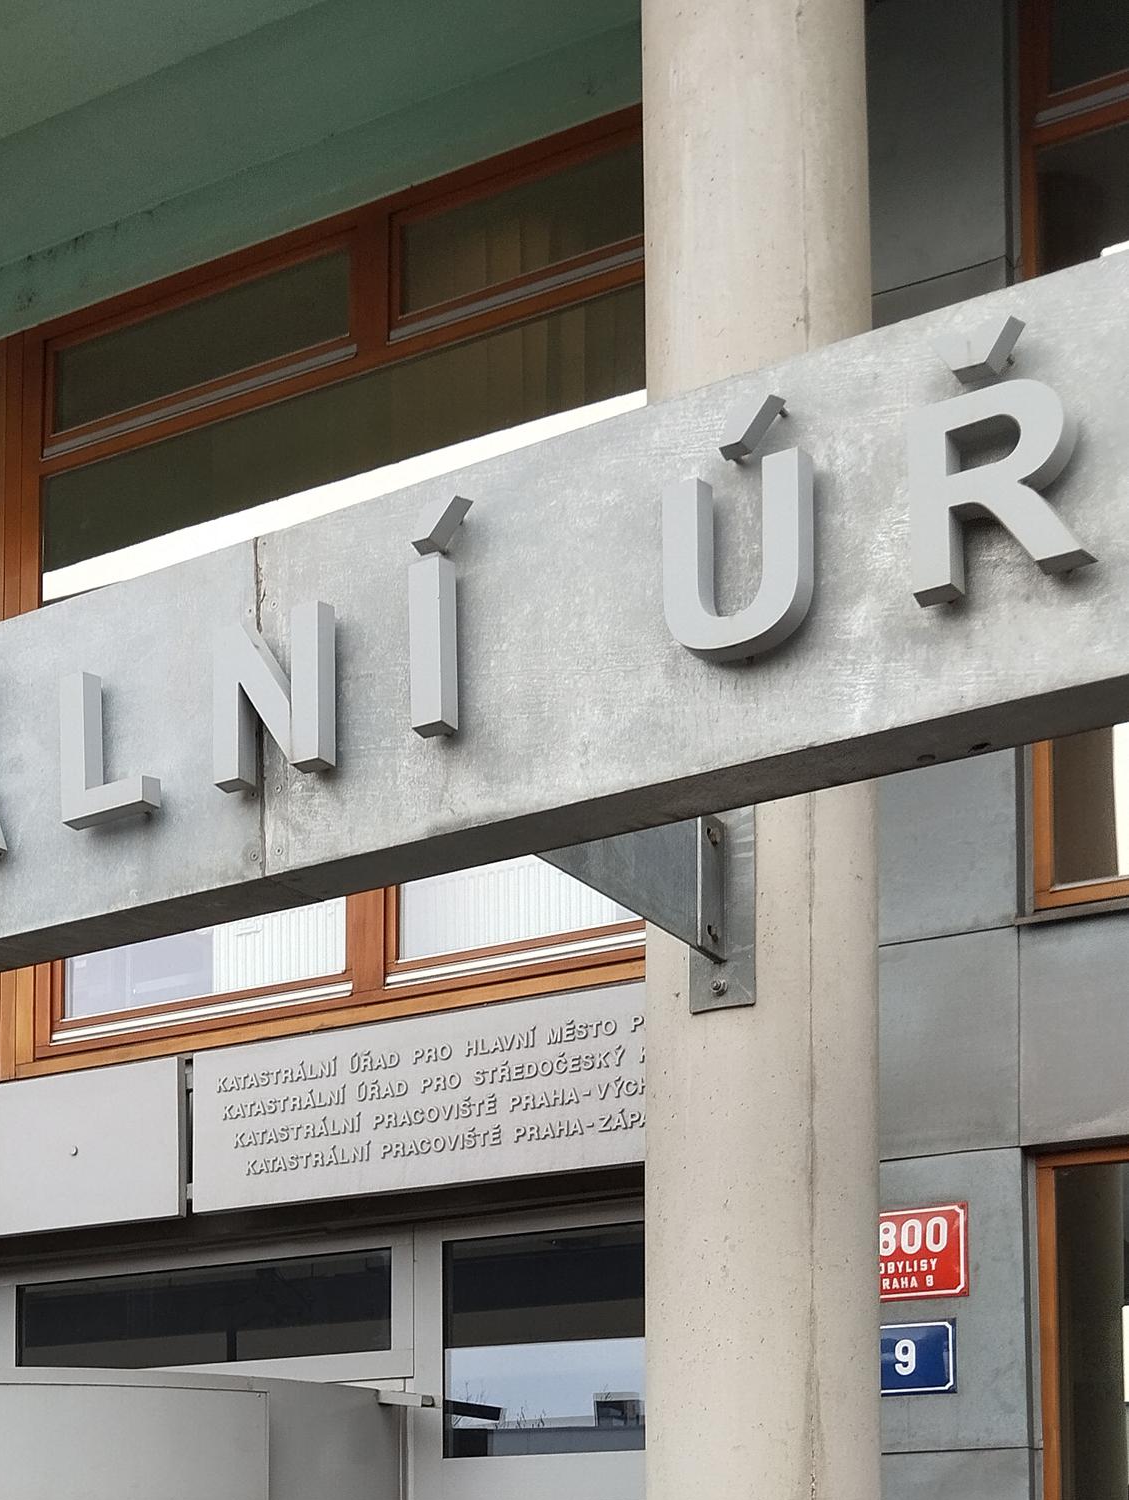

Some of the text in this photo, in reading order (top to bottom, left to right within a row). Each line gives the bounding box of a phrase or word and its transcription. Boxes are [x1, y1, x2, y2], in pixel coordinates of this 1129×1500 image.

[667, 315, 1098, 662] ÚŘ
[216, 1015, 646, 1093] KATASTRÁLNÍ ÚŘAD PRO HLAVNÍ MĚSTO P
[222, 1083, 346, 1121] KATASTRÁLNÍ
[356, 1079, 408, 1102] ÚŘAD
[421, 1072, 461, 1094] PRO
[473, 1045, 625, 1086] STŘEDOČESKÝ
[233, 1111, 361, 1149] KATASTRÁLNÍ
[373, 1093, 497, 1130] PRACOVIŠTĚ
[245, 1140, 371, 1176] KATASTRÁLNÍ
[380, 1124, 501, 1159] PRACOVIŠTĚ
[925, 1274, 934, 1288] 8
[894, 1339, 916, 1376] 9
